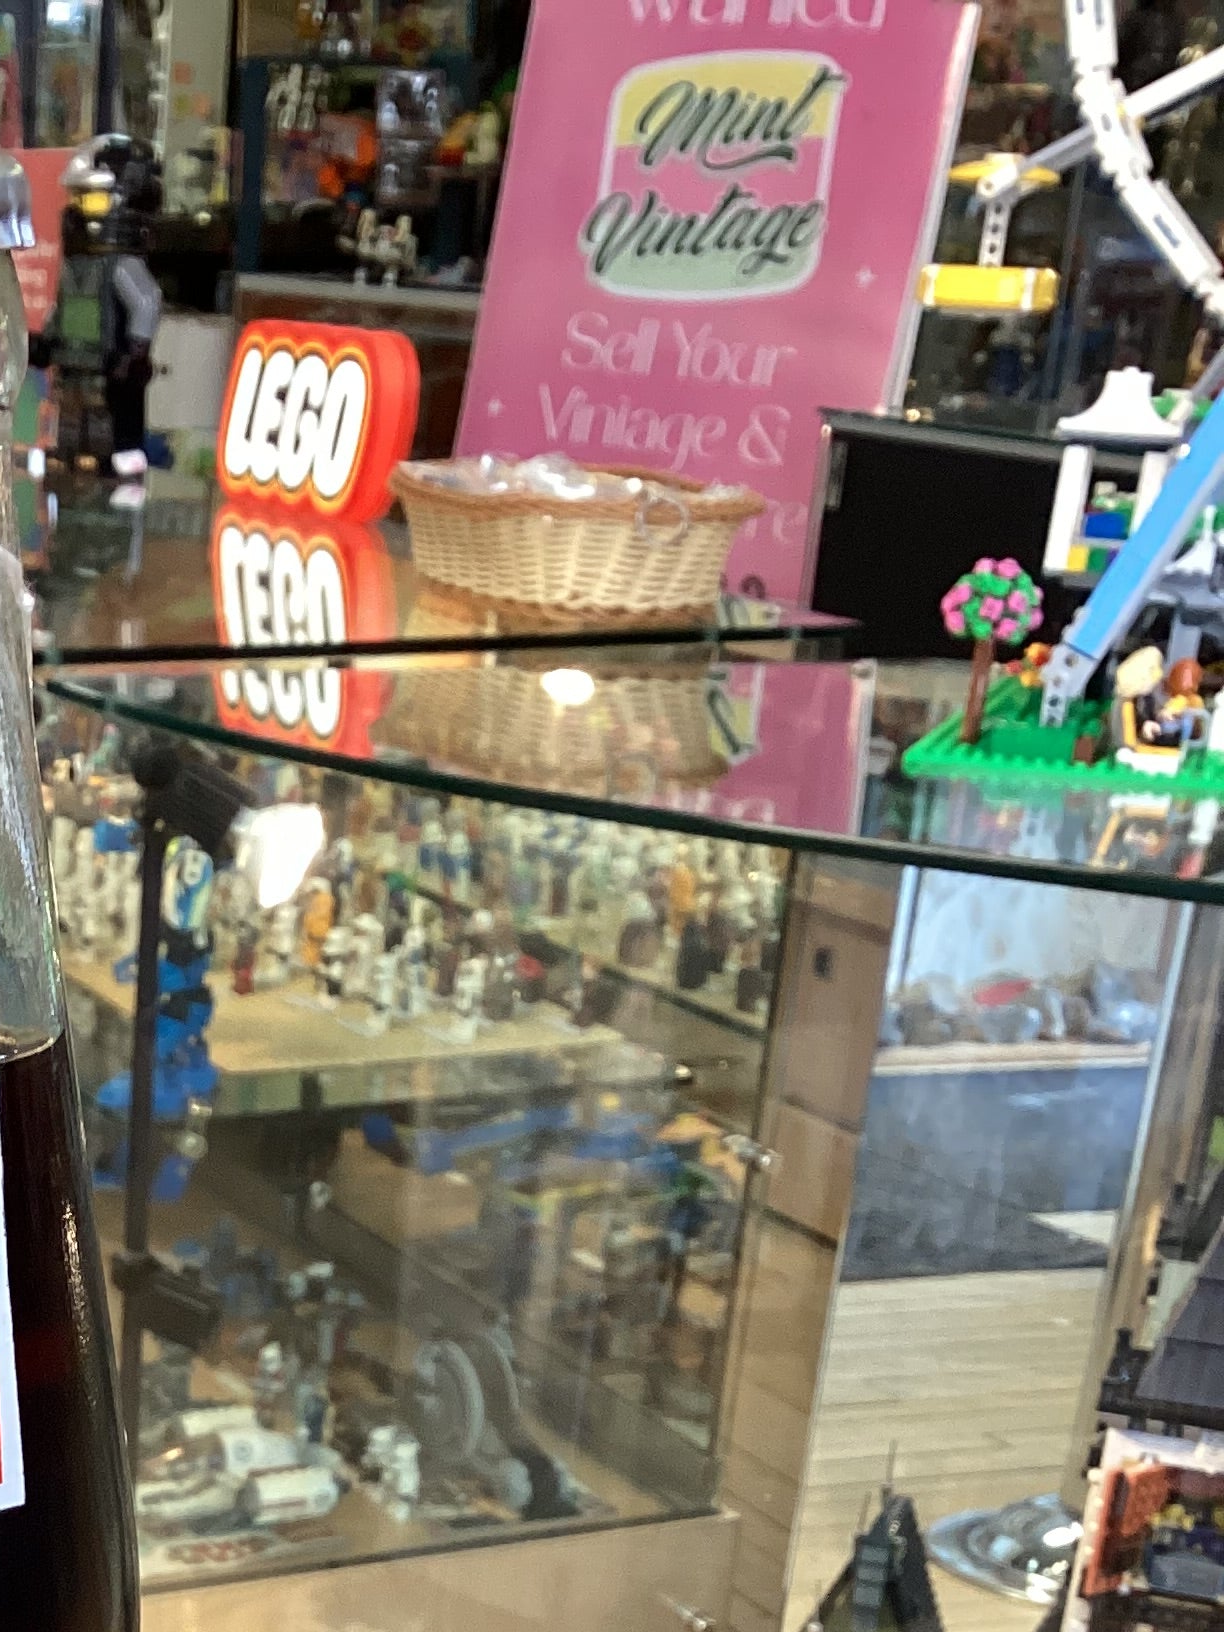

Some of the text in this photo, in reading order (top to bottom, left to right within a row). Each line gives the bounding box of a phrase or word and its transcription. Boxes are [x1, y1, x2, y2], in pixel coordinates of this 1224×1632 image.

[636, 64, 848, 171] Mint
[585, 183, 824, 278] Vintage
[560, 309, 798, 388] Sell Your
[224, 345, 367, 498] LEGO
[537, 382, 727, 471] Vintage
